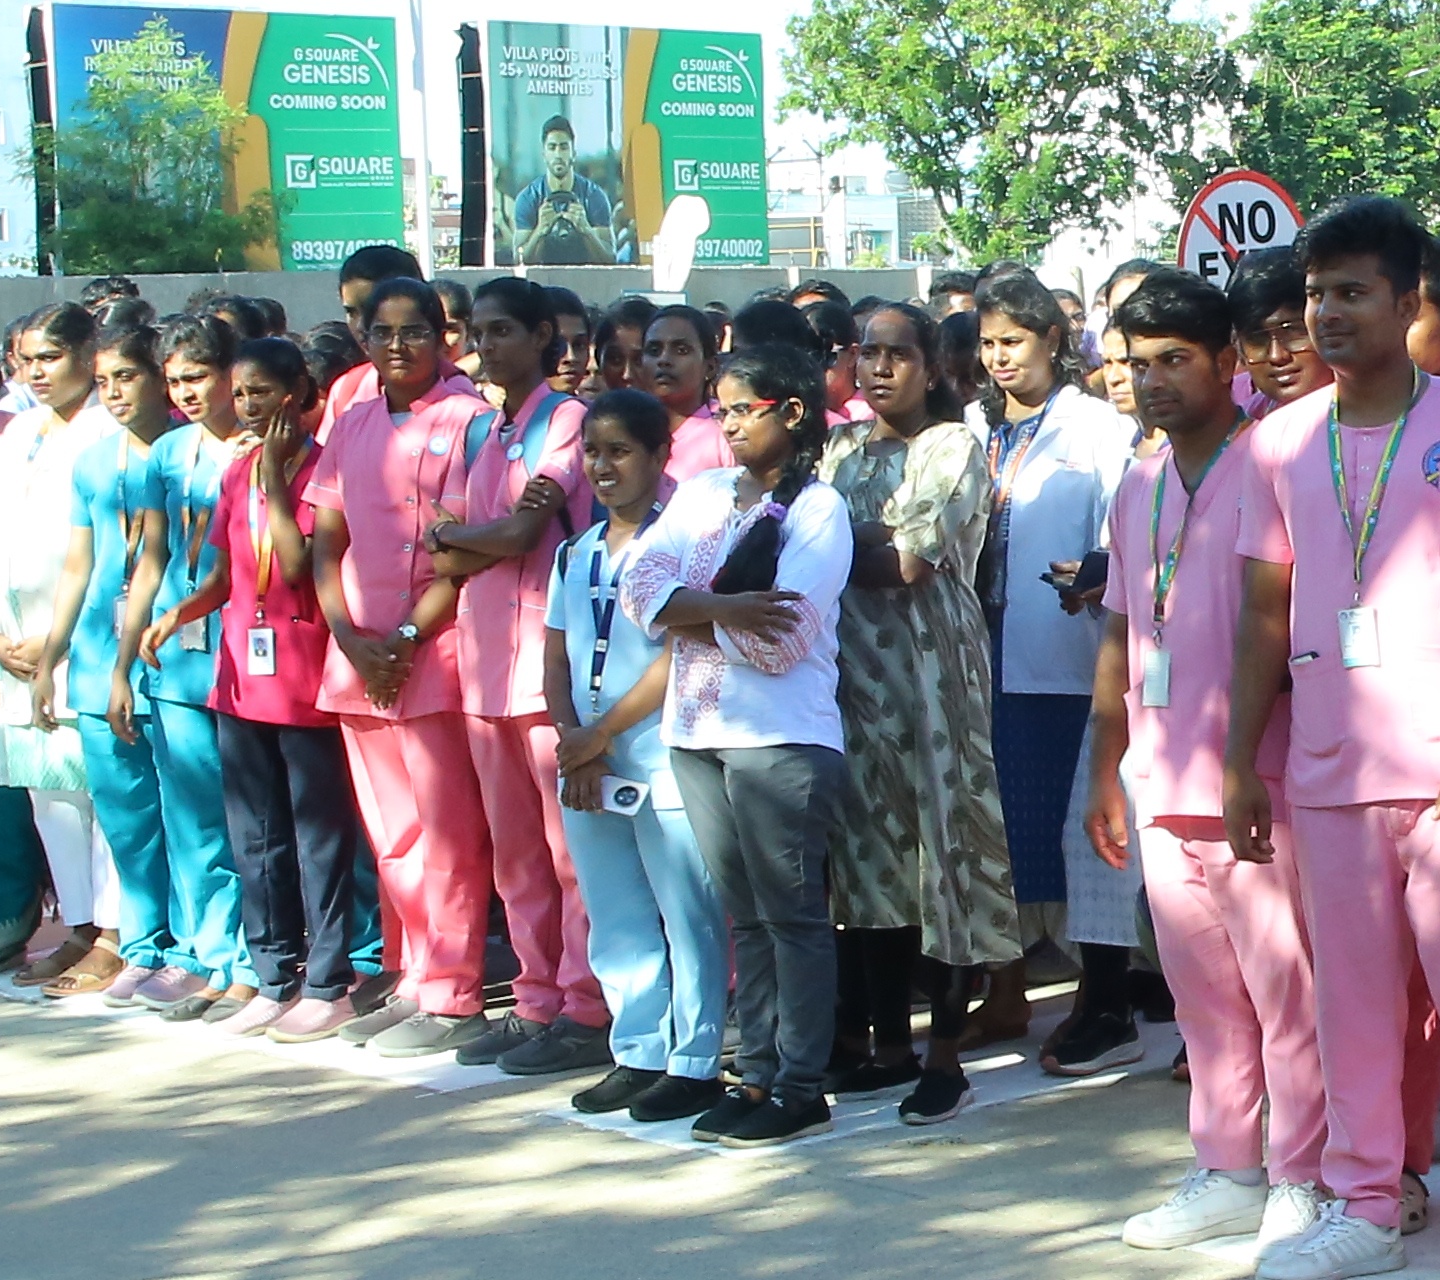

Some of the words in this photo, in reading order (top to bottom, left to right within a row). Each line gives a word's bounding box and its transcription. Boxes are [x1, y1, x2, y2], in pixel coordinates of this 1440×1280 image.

[293, 48, 303, 61] G
[305, 48, 360, 62] SQUARE
[502, 46, 539, 61] VILLA
[541, 47, 579, 62] PLOTS
[283, 63, 371, 85] GENESIS
[499, 62, 524, 77] 25+
[680, 58, 688, 71] G
[690, 59, 733, 73] SQUARE
[526, 80, 594, 96] AMENITIES
[672, 73, 743, 93] GENESIS
[269, 94, 337, 110] COMING
[341, 95, 387, 110] SOON
[660, 101, 716, 116] COMING
[718, 103, 755, 118] SOON
[318, 156, 394, 175] SQUARE
[700, 162, 760, 179] SQUARE
[1217, 200, 1276, 246] NO
[695, 239, 764, 258] 39740002
